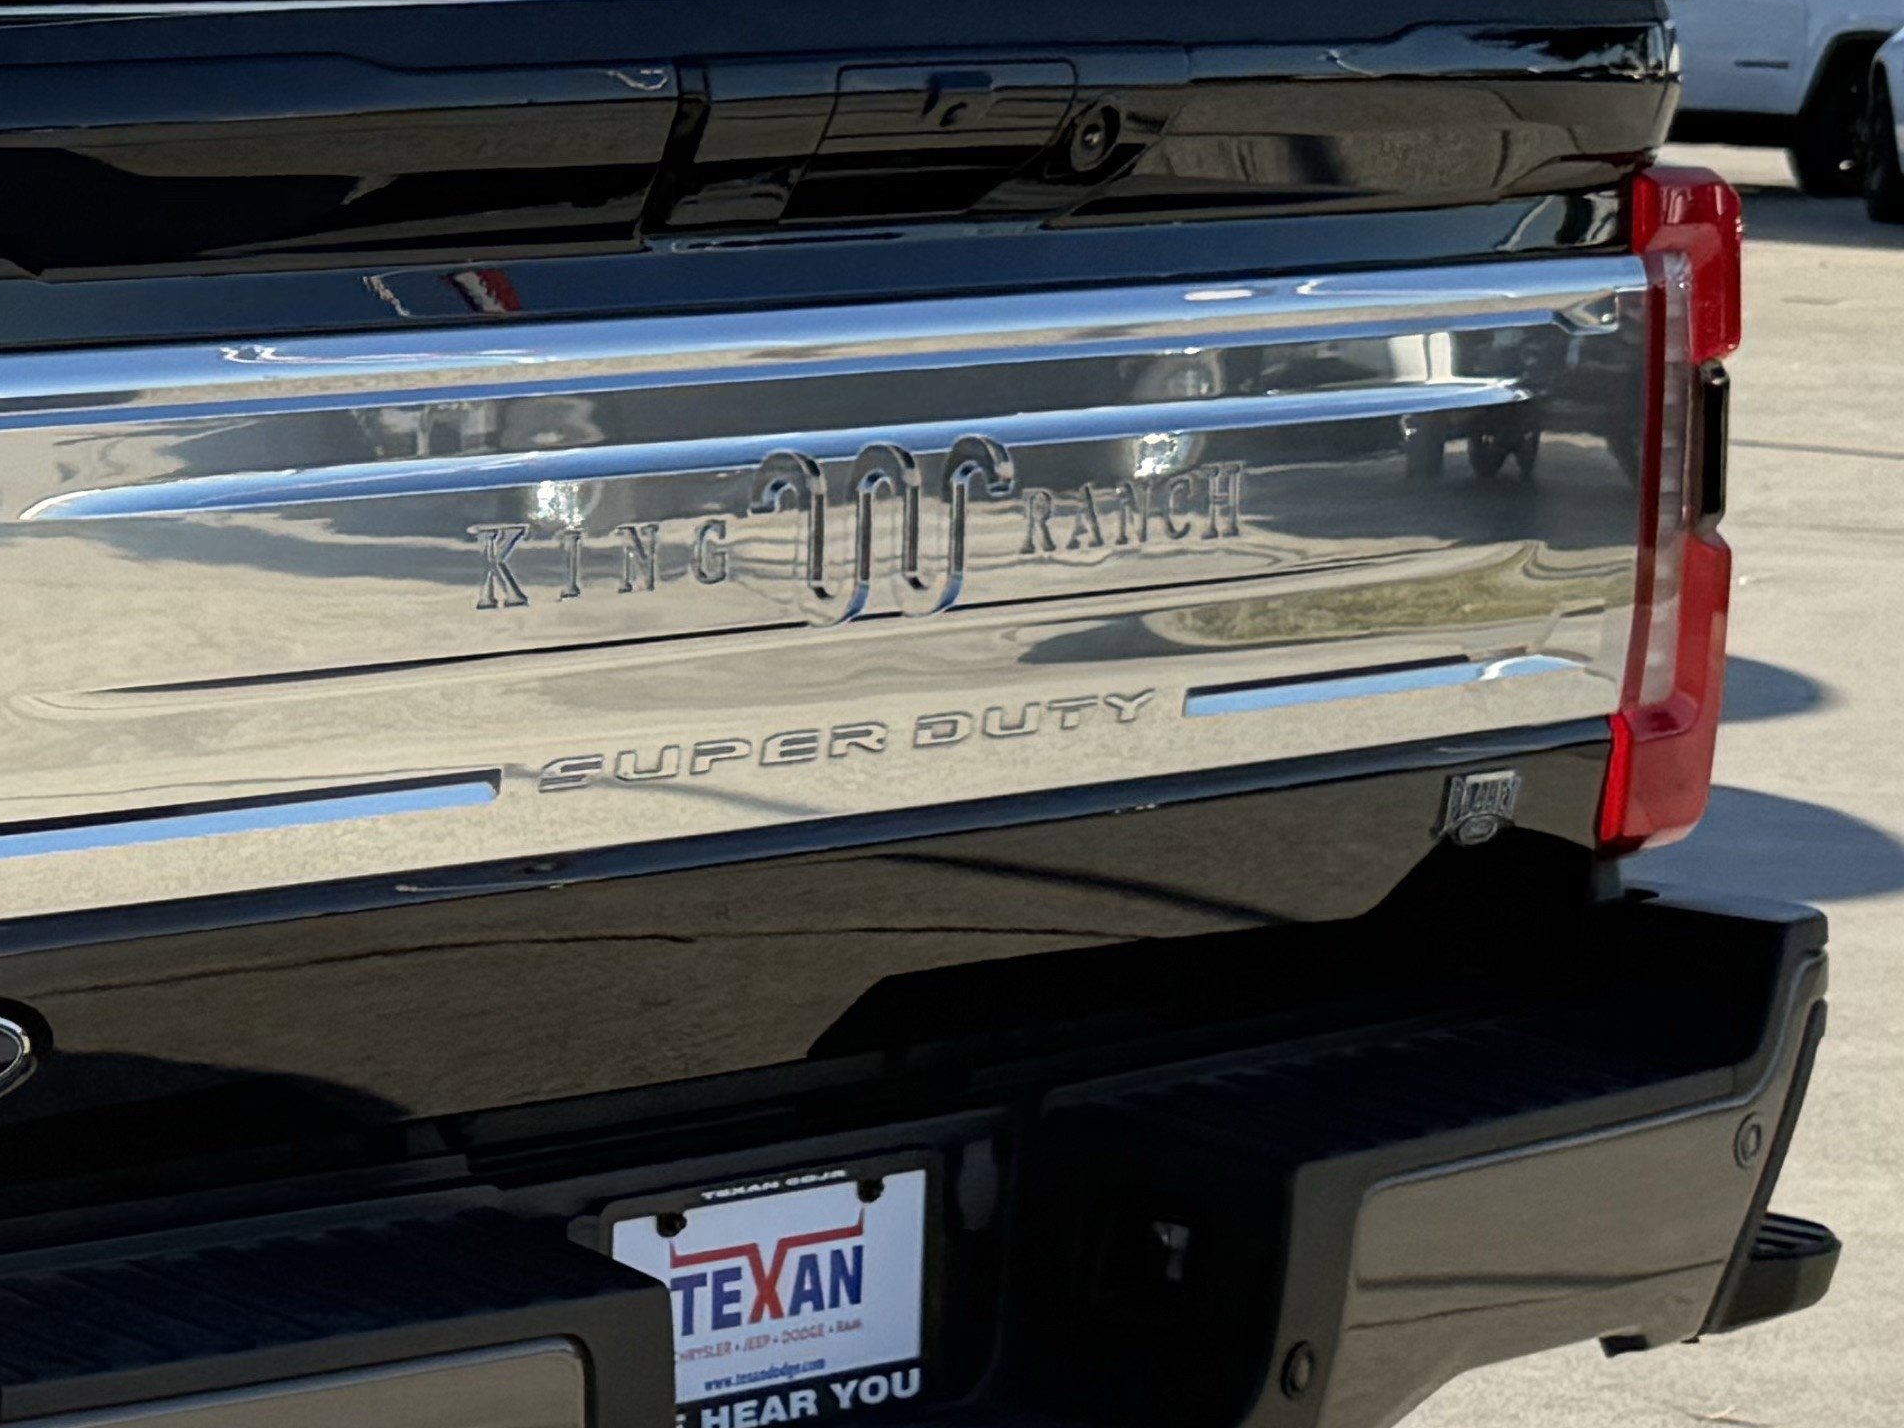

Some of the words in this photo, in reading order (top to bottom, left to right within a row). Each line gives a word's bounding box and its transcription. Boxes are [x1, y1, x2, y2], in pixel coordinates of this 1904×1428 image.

[473, 519, 731, 610] KING
[1020, 460, 1246, 555] RANCH
[538, 721, 888, 794] SUPER
[912, 686, 1157, 750] DUTY
[700, 1179, 779, 1200] TEXAN
[669, 1209, 864, 1336] TEXAN
[780, 1323, 825, 1345] DODGE
[830, 1367, 922, 1411] YOU
